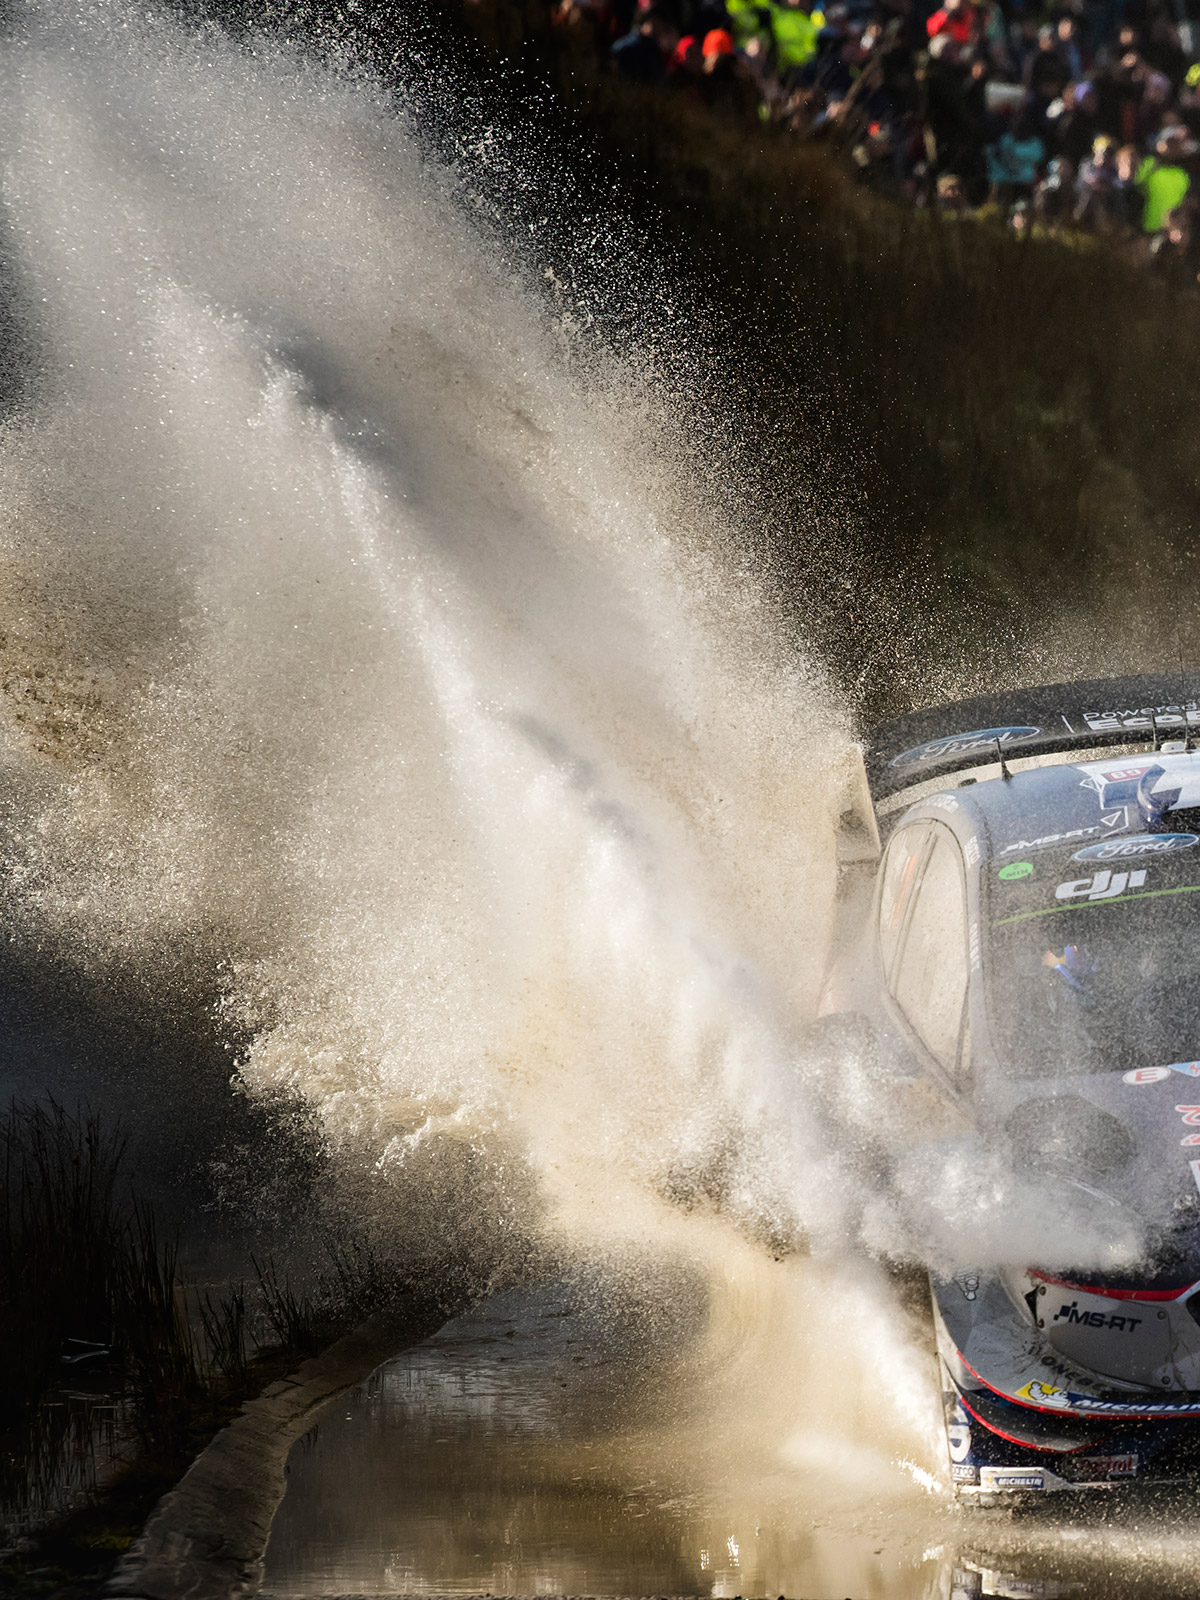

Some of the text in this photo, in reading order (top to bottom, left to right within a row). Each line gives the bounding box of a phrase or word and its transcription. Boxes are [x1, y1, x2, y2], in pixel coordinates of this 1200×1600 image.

[1082, 703, 1197, 721] Powered
[919, 731, 1014, 761] Ford
[1097, 837, 1177, 859] Ford
[1068, 1308, 1142, 1332] MS-RT
[998, 1478, 1043, 1486] MICHELIN
